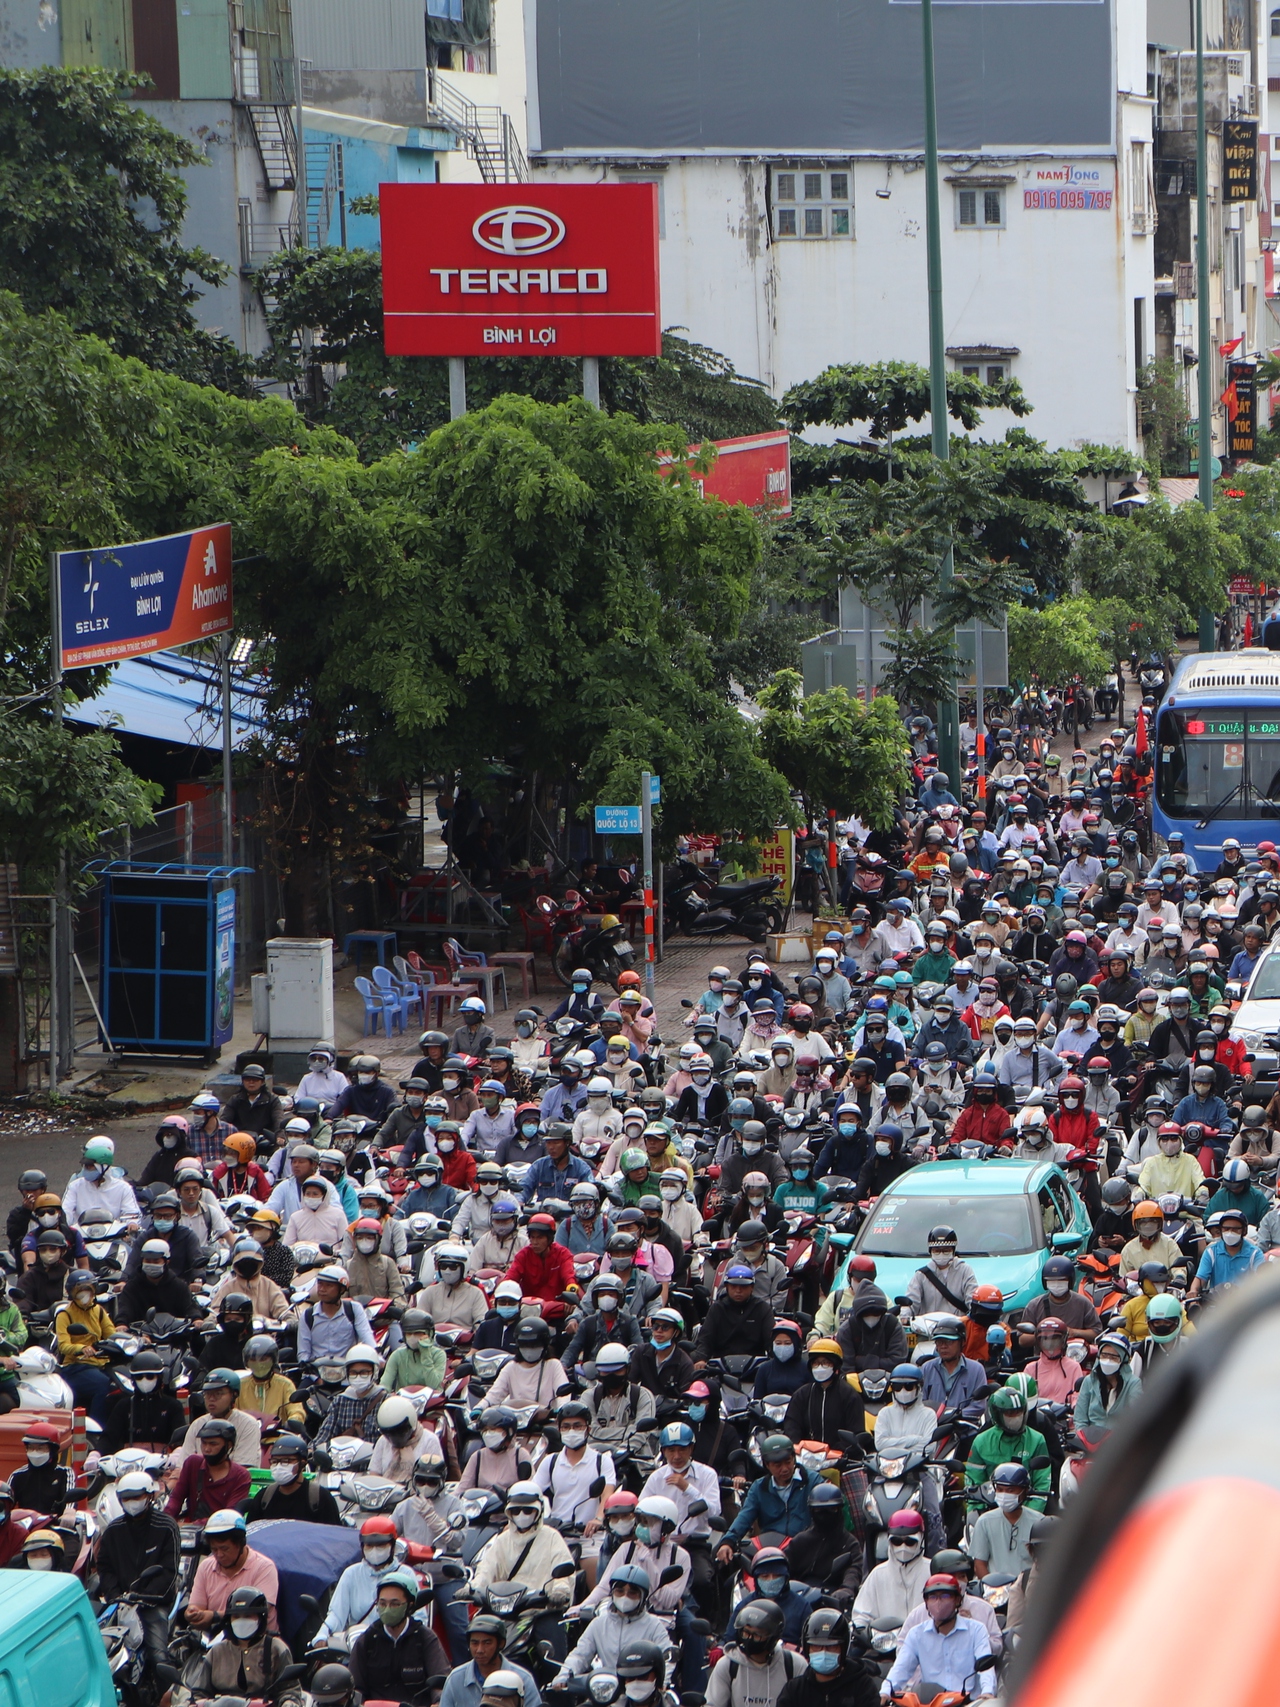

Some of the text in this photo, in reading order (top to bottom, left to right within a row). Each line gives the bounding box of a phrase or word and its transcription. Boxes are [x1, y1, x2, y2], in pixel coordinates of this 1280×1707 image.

[1037, 164, 1099, 185] NAM LONG
[1024, 190, 1112, 209] 0916 095 795
[429, 268, 608, 294] TERACO
[483, 325, 556, 347] BÌNH LỢI
[1235, 418, 1251, 433] TÓC
[1233, 438, 1253, 450] NAM
[192, 583, 228, 610] Ahamove
[137, 595, 150, 617] BÌNH
[75, 617, 110, 634] SELEX
[1218, 722, 1245, 736] QUẬ
[1261, 723, 1279, 736] ĐẠI
[1225, 744, 1244, 766] 8
[597, 816, 638, 831] QUỐC LỘ 13
[759, 846, 785, 859] HÊ
[872, 1226, 894, 1234] TAXI
